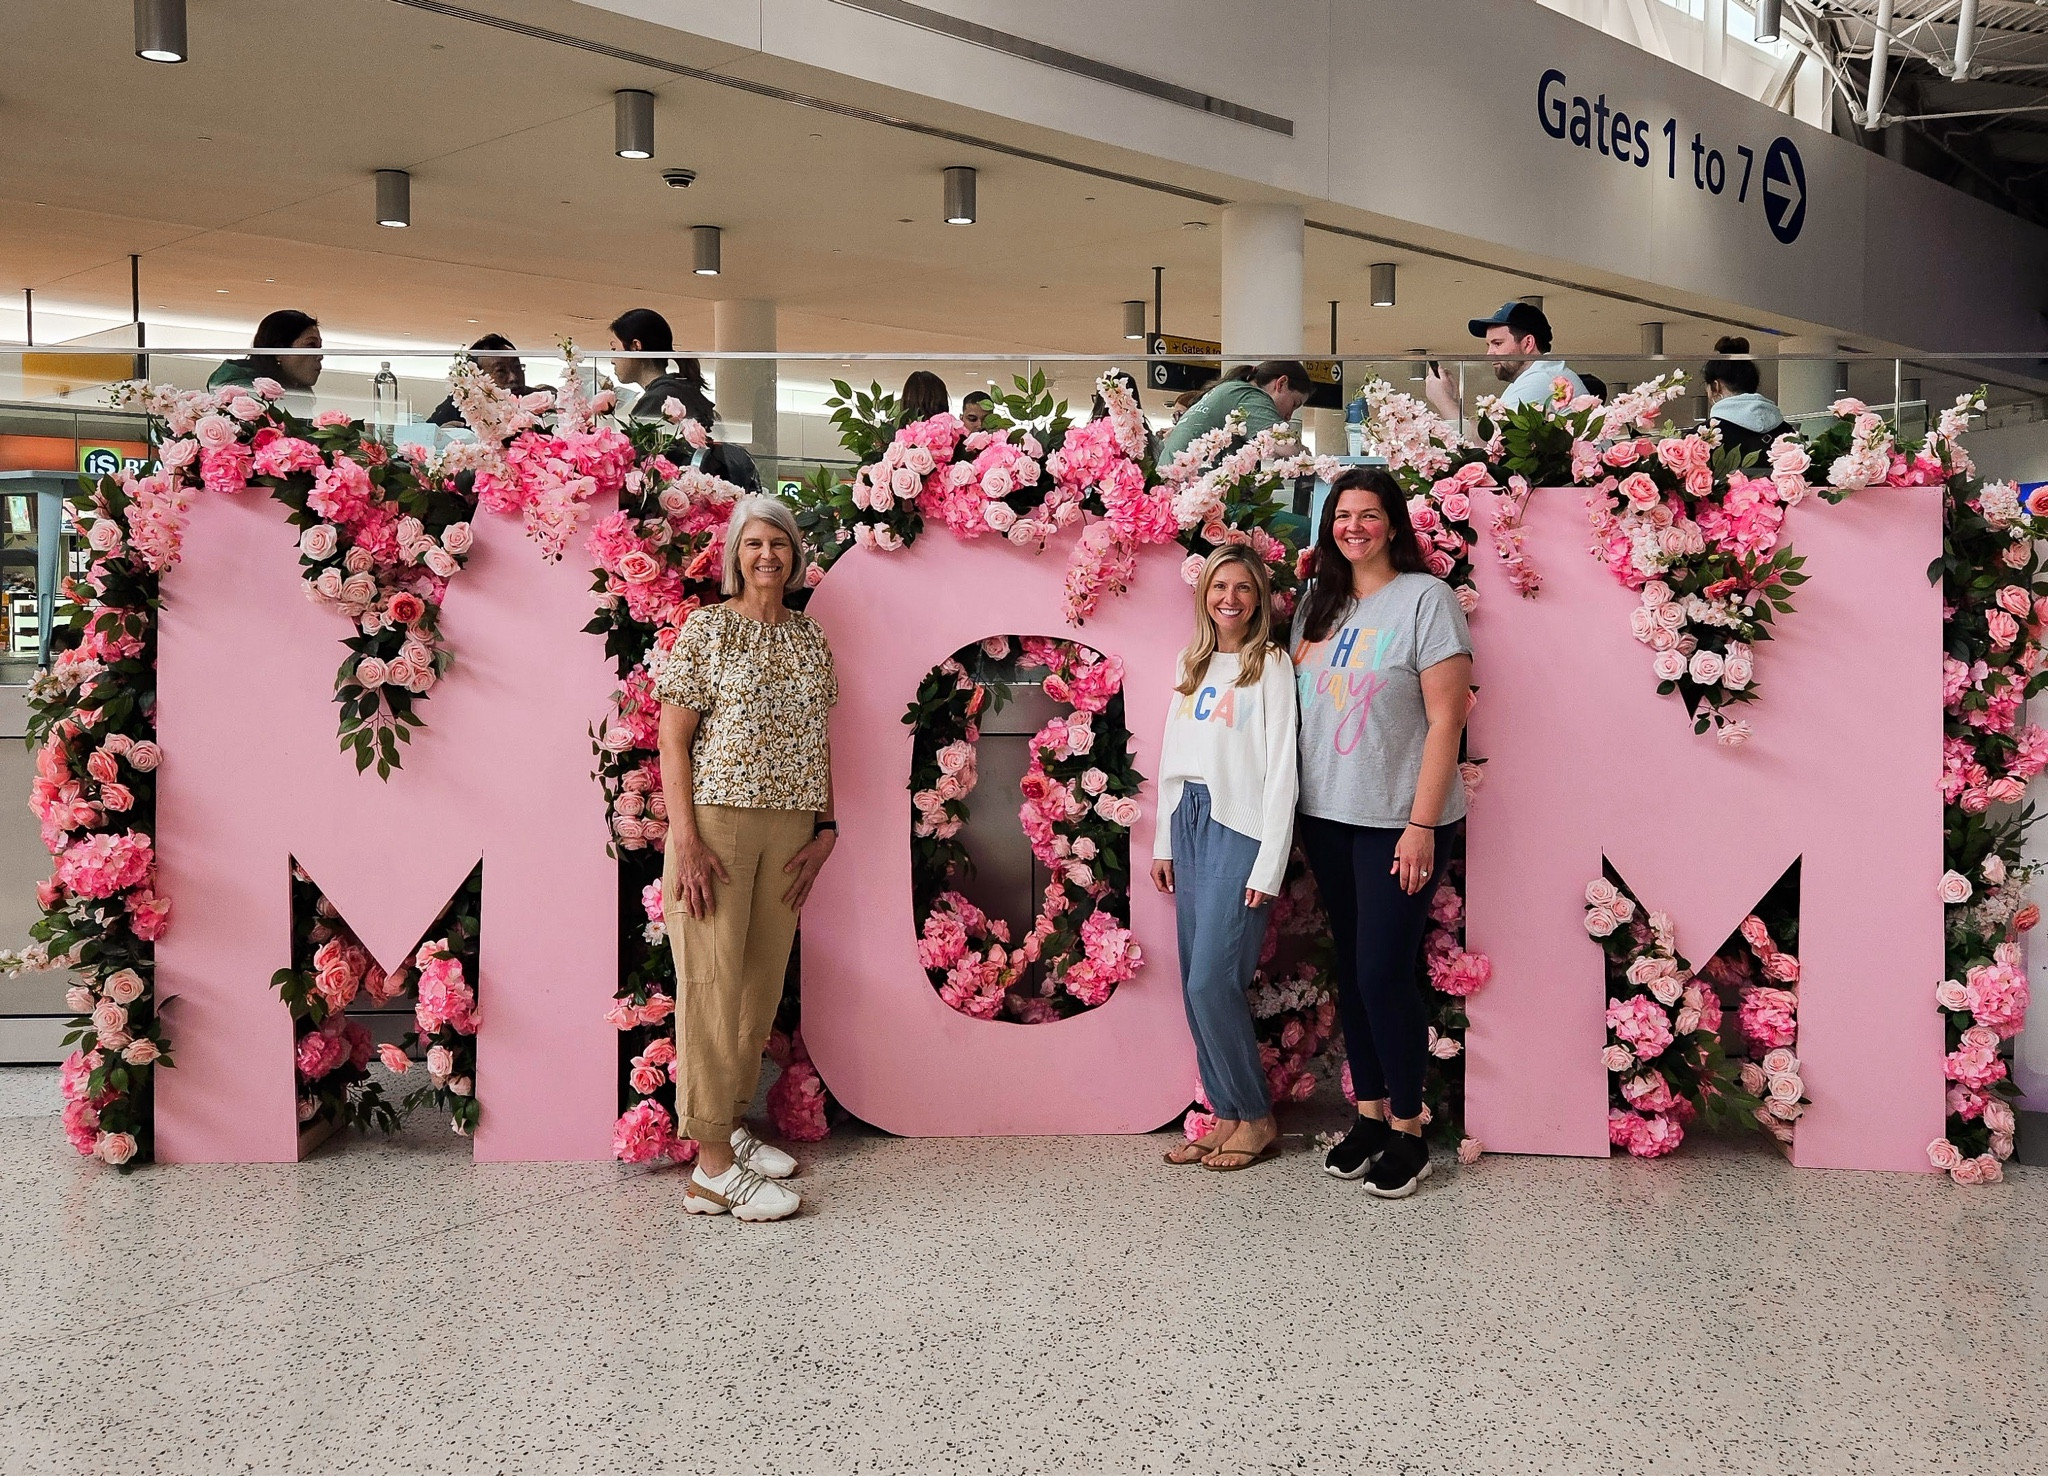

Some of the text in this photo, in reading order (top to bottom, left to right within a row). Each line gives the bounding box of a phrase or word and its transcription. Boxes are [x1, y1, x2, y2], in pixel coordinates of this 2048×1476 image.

[1537, 68, 1754, 204] Gates 1 to 7
[1182, 342, 1204, 354] Gates
[1306, 361, 1320, 372] to 7
[1331, 627, 1396, 670] HEY
[1175, 686, 1255, 731] ACAY
[1299, 669, 1389, 756] acay
